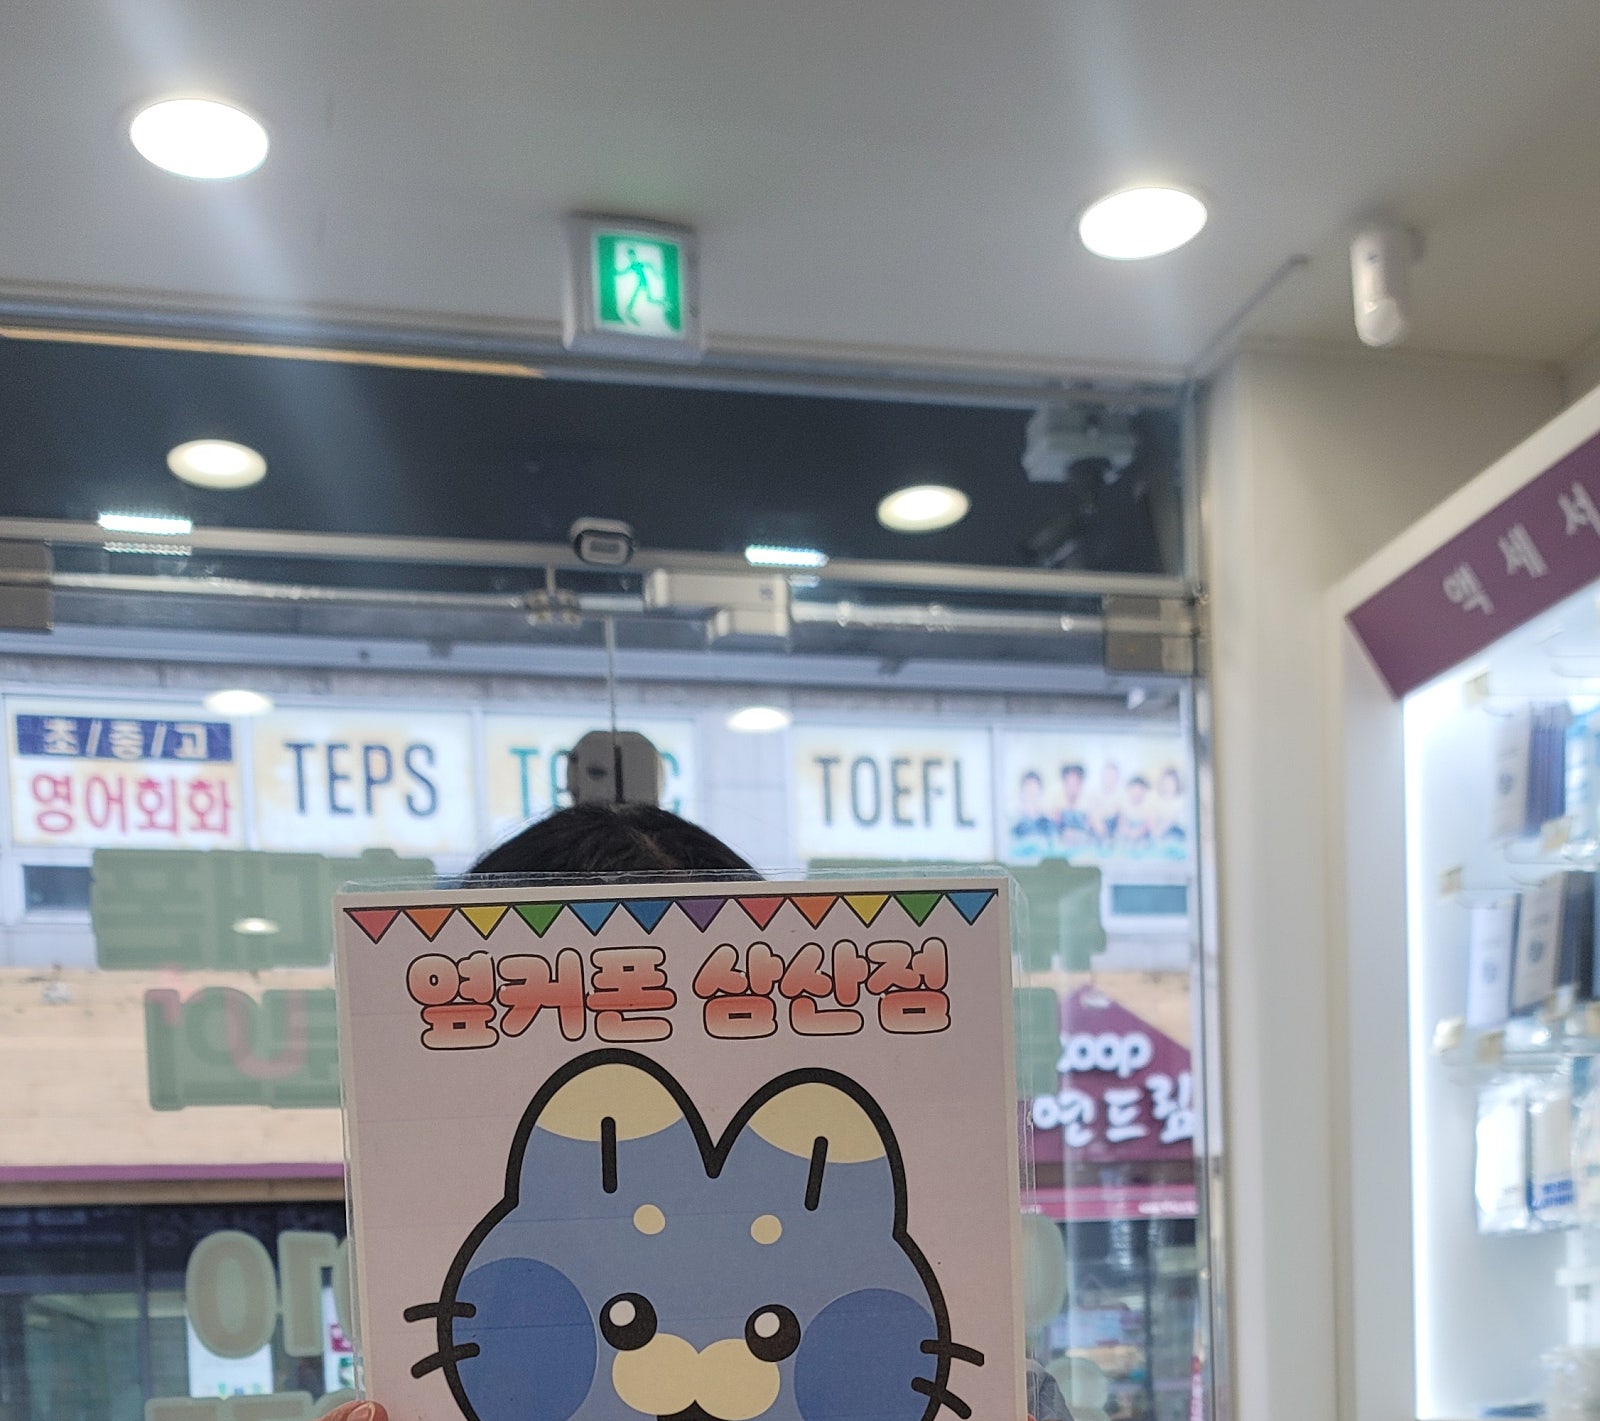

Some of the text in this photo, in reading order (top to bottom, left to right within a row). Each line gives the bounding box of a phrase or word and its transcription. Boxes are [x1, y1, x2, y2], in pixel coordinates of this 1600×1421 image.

[30, 771, 232, 837] 영어회화
[283, 742, 440, 819] TEPS
[813, 754, 976, 830] TOEFL
[406, 947, 678, 1051] 옆커폰
[693, 936, 952, 1039] 삼산점
[1032, 1072, 1198, 1148] 연드림
